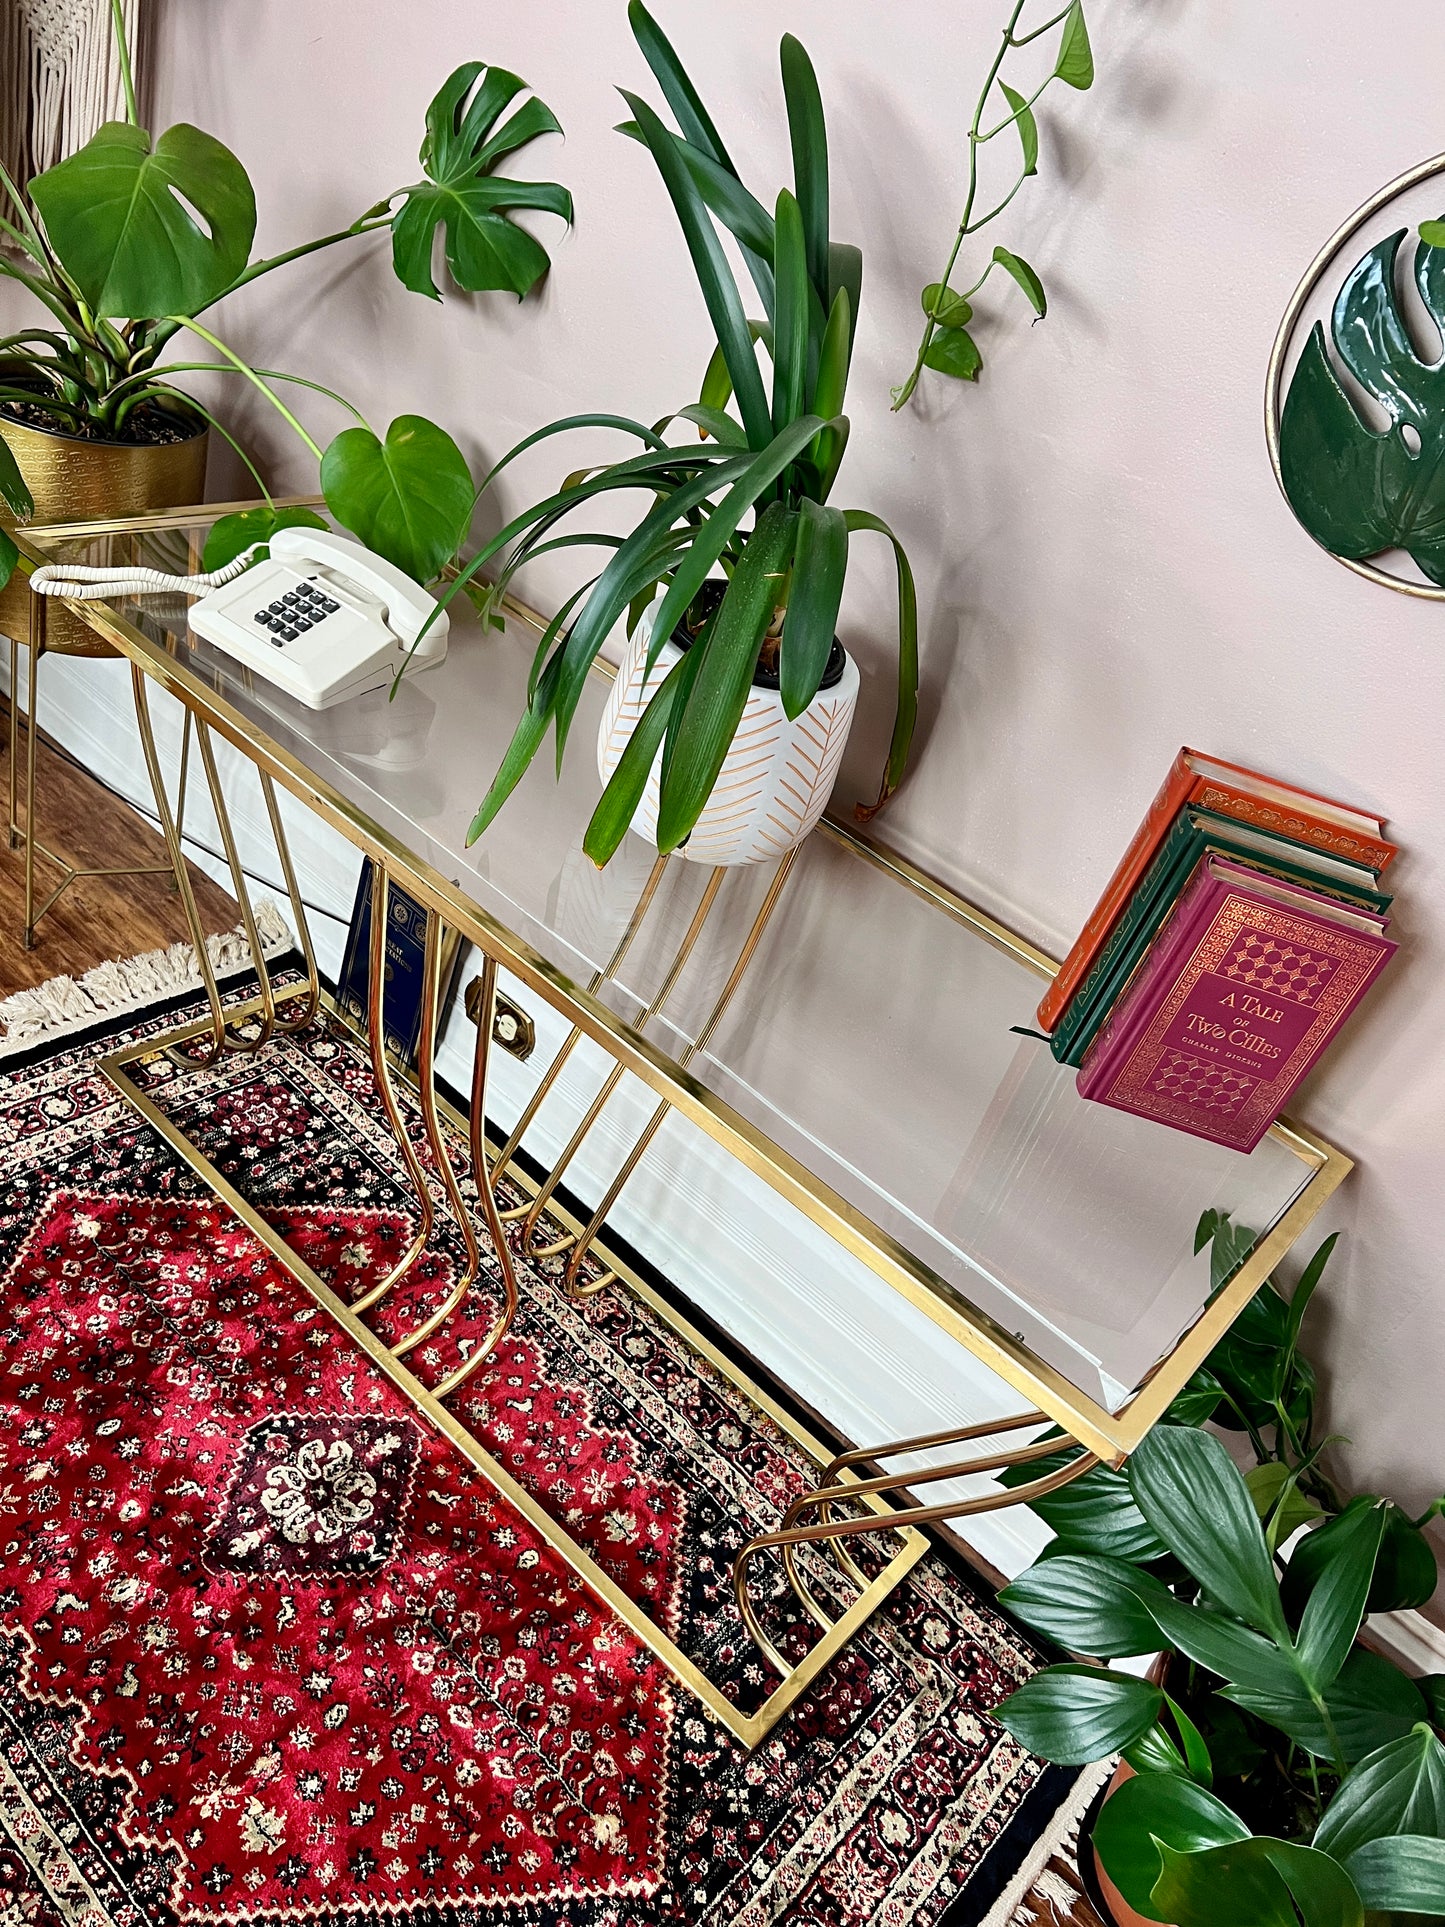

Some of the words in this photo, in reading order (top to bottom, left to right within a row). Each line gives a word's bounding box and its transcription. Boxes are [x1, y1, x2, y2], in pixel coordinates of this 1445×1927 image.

[386, 937, 404, 955] REAT
[1218, 992, 1236, 1008] A
[1241, 994, 1284, 1024] TALE
[1233, 1017, 1250, 1027] OF
[1186, 1013, 1227, 1039] TWO
[1228, 1029, 1282, 1059] CITIES
[1182, 1036, 1220, 1053] CHARLES
[1225, 1051, 1262, 1069] DICKENS
